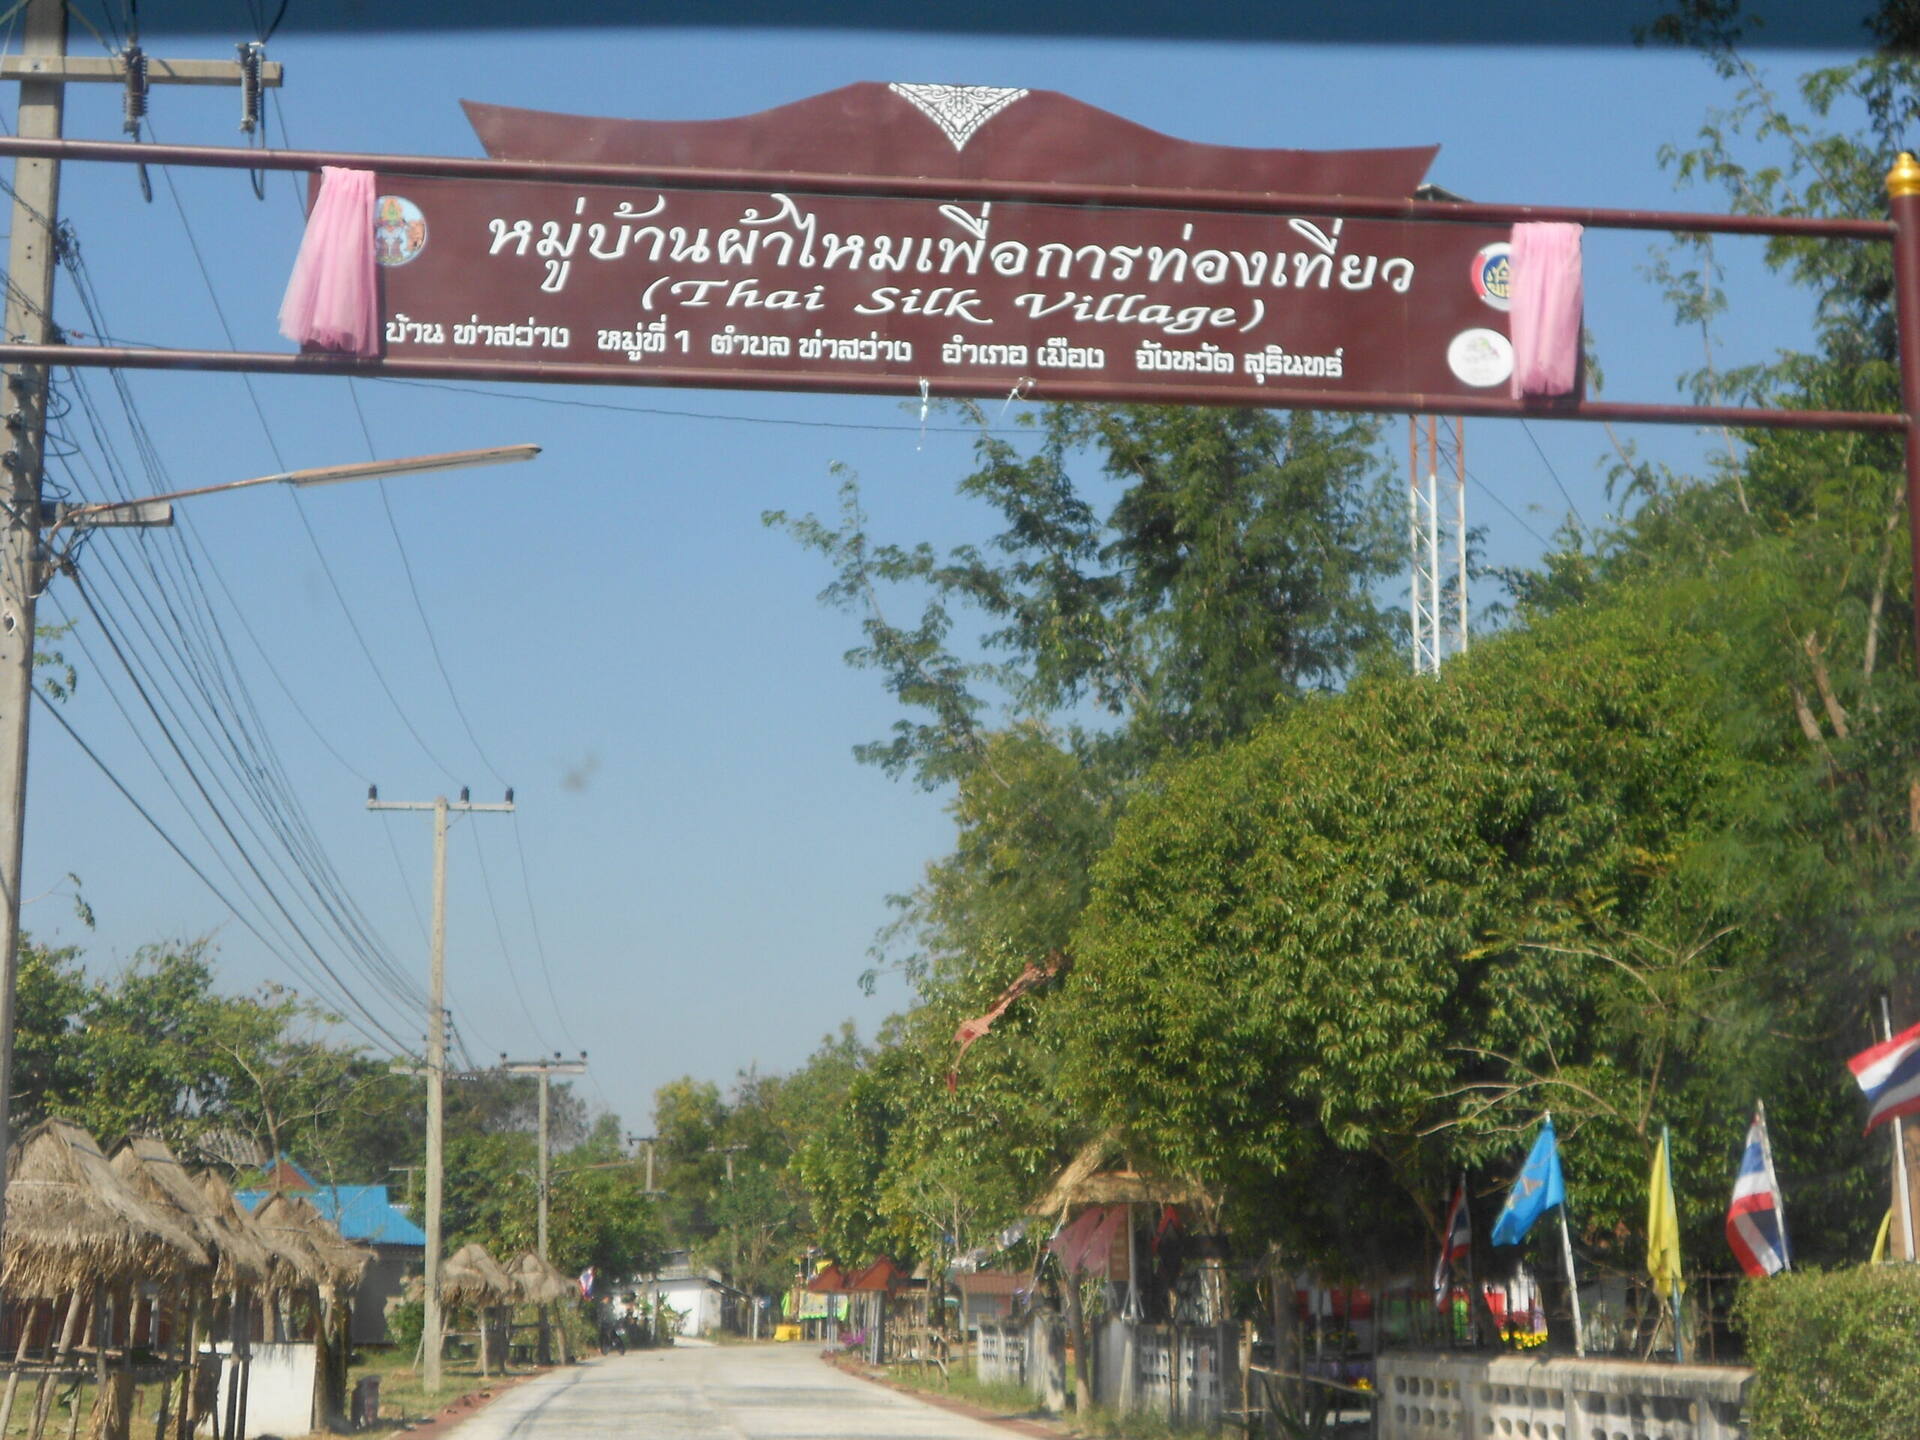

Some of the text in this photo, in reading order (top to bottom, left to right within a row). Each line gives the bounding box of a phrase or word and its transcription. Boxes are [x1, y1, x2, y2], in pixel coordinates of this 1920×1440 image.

[488, 192, 1415, 293] หมู่บ้านผ้าไหมเพื่อการท่องเที่ยว
[641, 276, 1265, 335] (Thai Silk Village)
[385, 313, 1344, 385] บ้าน ท่าสว่าง หมู่ที่ 1 ตำบล ท่าสว่าง อำเภอ เมือง จังหวัด สุรินทร์
